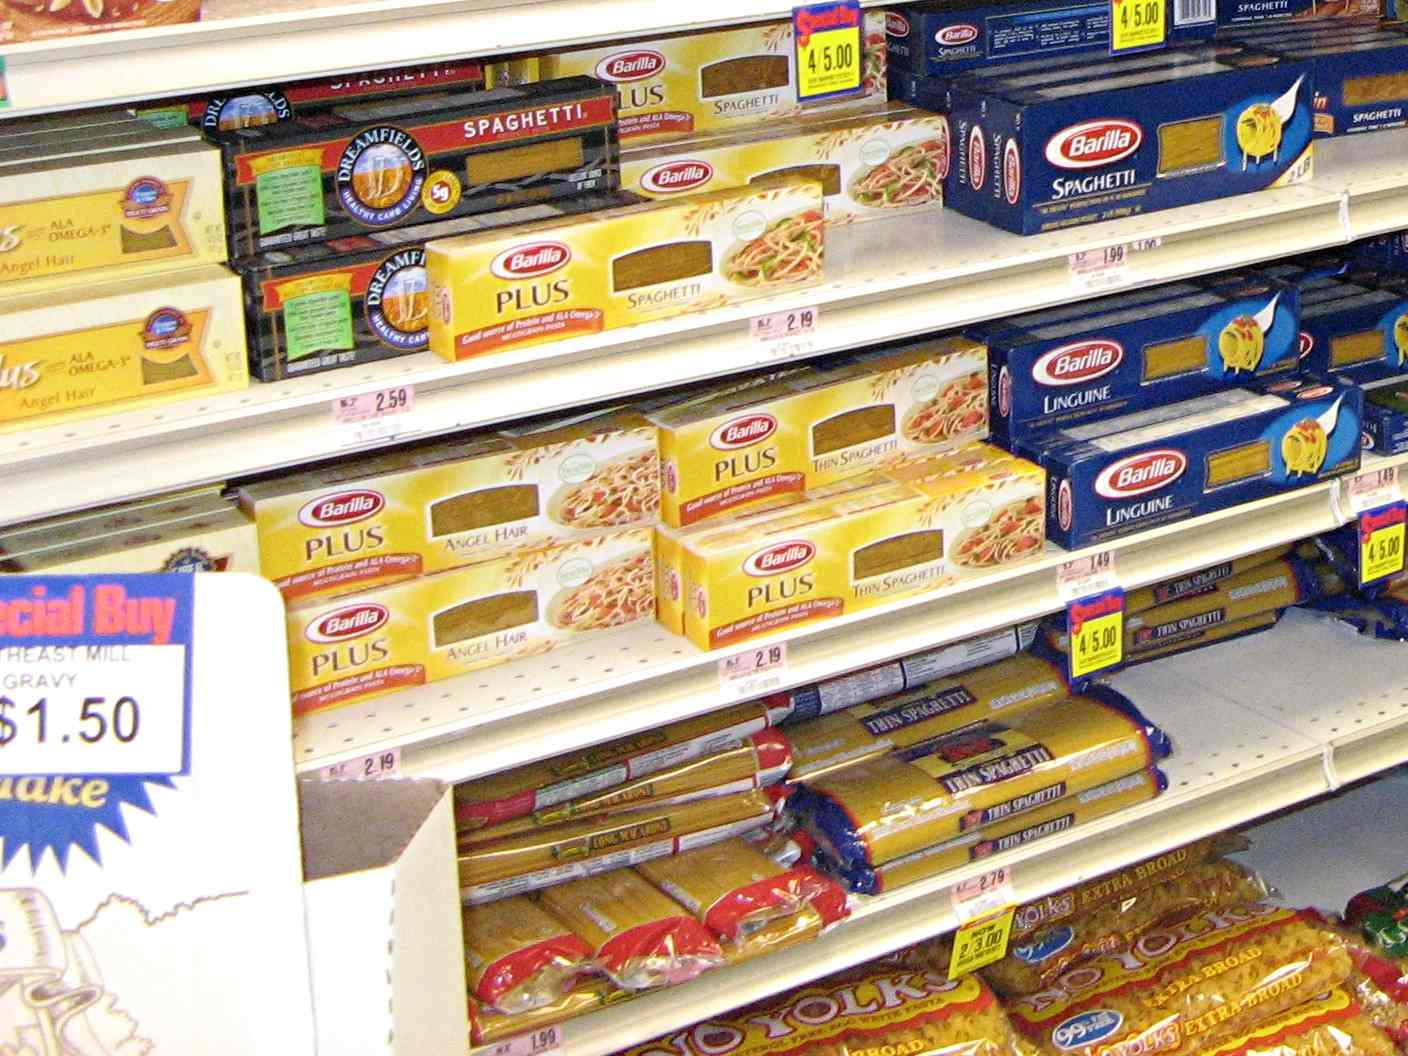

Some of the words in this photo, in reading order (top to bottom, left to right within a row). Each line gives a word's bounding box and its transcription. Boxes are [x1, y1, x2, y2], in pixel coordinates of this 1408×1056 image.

[1237, 0, 1288, 13] SPAGHETTI
[611, 55, 658, 75] Barilla
[714, 93, 779, 115] SPAGHETTI
[1352, 109, 1403, 124] SPAGHETTI
[464, 103, 583, 138] SPAGHETTI
[338, 128, 424, 181] DREAMFIELDS
[1069, 131, 1131, 156] Barilla
[658, 163, 710, 185] Barilla
[1052, 169, 1137, 199] SPAGHETTI
[432, 183, 449, 201] 5g
[433, 185, 449, 201] 5g
[50, 218, 73, 230] ALA
[510, 249, 562, 270] Barilla
[1103, 247, 1124, 264] 1.99
[495, 280, 570, 313] PLUS
[627, 284, 701, 310] SPAGHETTI
[787, 312, 813, 330] 2.19
[70, 351, 94, 364] ALA
[1054, 347, 1113, 375] Barilla
[19, 393, 60, 409] Angel
[65, 389, 95, 402] Hair
[376, 389, 407, 410] 2.59
[1044, 386, 1111, 413] LINGUINE
[726, 421, 770, 442] Barilla
[715, 448, 777, 482] PLUS
[813, 454, 840, 472] THIN
[840, 440, 898, 466] SPAGHETTI
[1118, 458, 1176, 488] Barilla
[320, 497, 374, 519] Barilla
[1106, 496, 1174, 526] LINGUINE
[305, 526, 384, 560] PLUS
[444, 534, 489, 552] ANGEL
[496, 525, 528, 542] HAIR
[760, 545, 810, 570] Barilla
[748, 574, 814, 607] PLUS
[852, 579, 882, 599] THIN
[881, 565, 945, 591] SPAGHETTI
[93, 584, 176, 644] Buy
[326, 609, 379, 634] Barilla
[1177, 611, 1221, 629] SPAGHETTI
[86, 646, 130, 662] MILL
[312, 640, 389, 677] PLUS
[447, 643, 488, 660] ANGEL
[496, 631, 527, 649] HAIR
[756, 646, 781, 667] 2.19
[2, 673, 79, 689] GRAVY
[0, 696, 140, 748] $1.50
[866, 714, 901, 734] THIN
[902, 691, 972, 723] SPAGHETTI
[365, 753, 395, 776] 2.19
[980, 748, 1050, 782] SPAGHETTI
[1012, 783, 1062, 812] SPAGHETTI
[1022, 816, 1071, 842] SPAGHETTI
[1135, 849, 1188, 886] BROAD
[1202, 944, 1263, 984] BROAD
